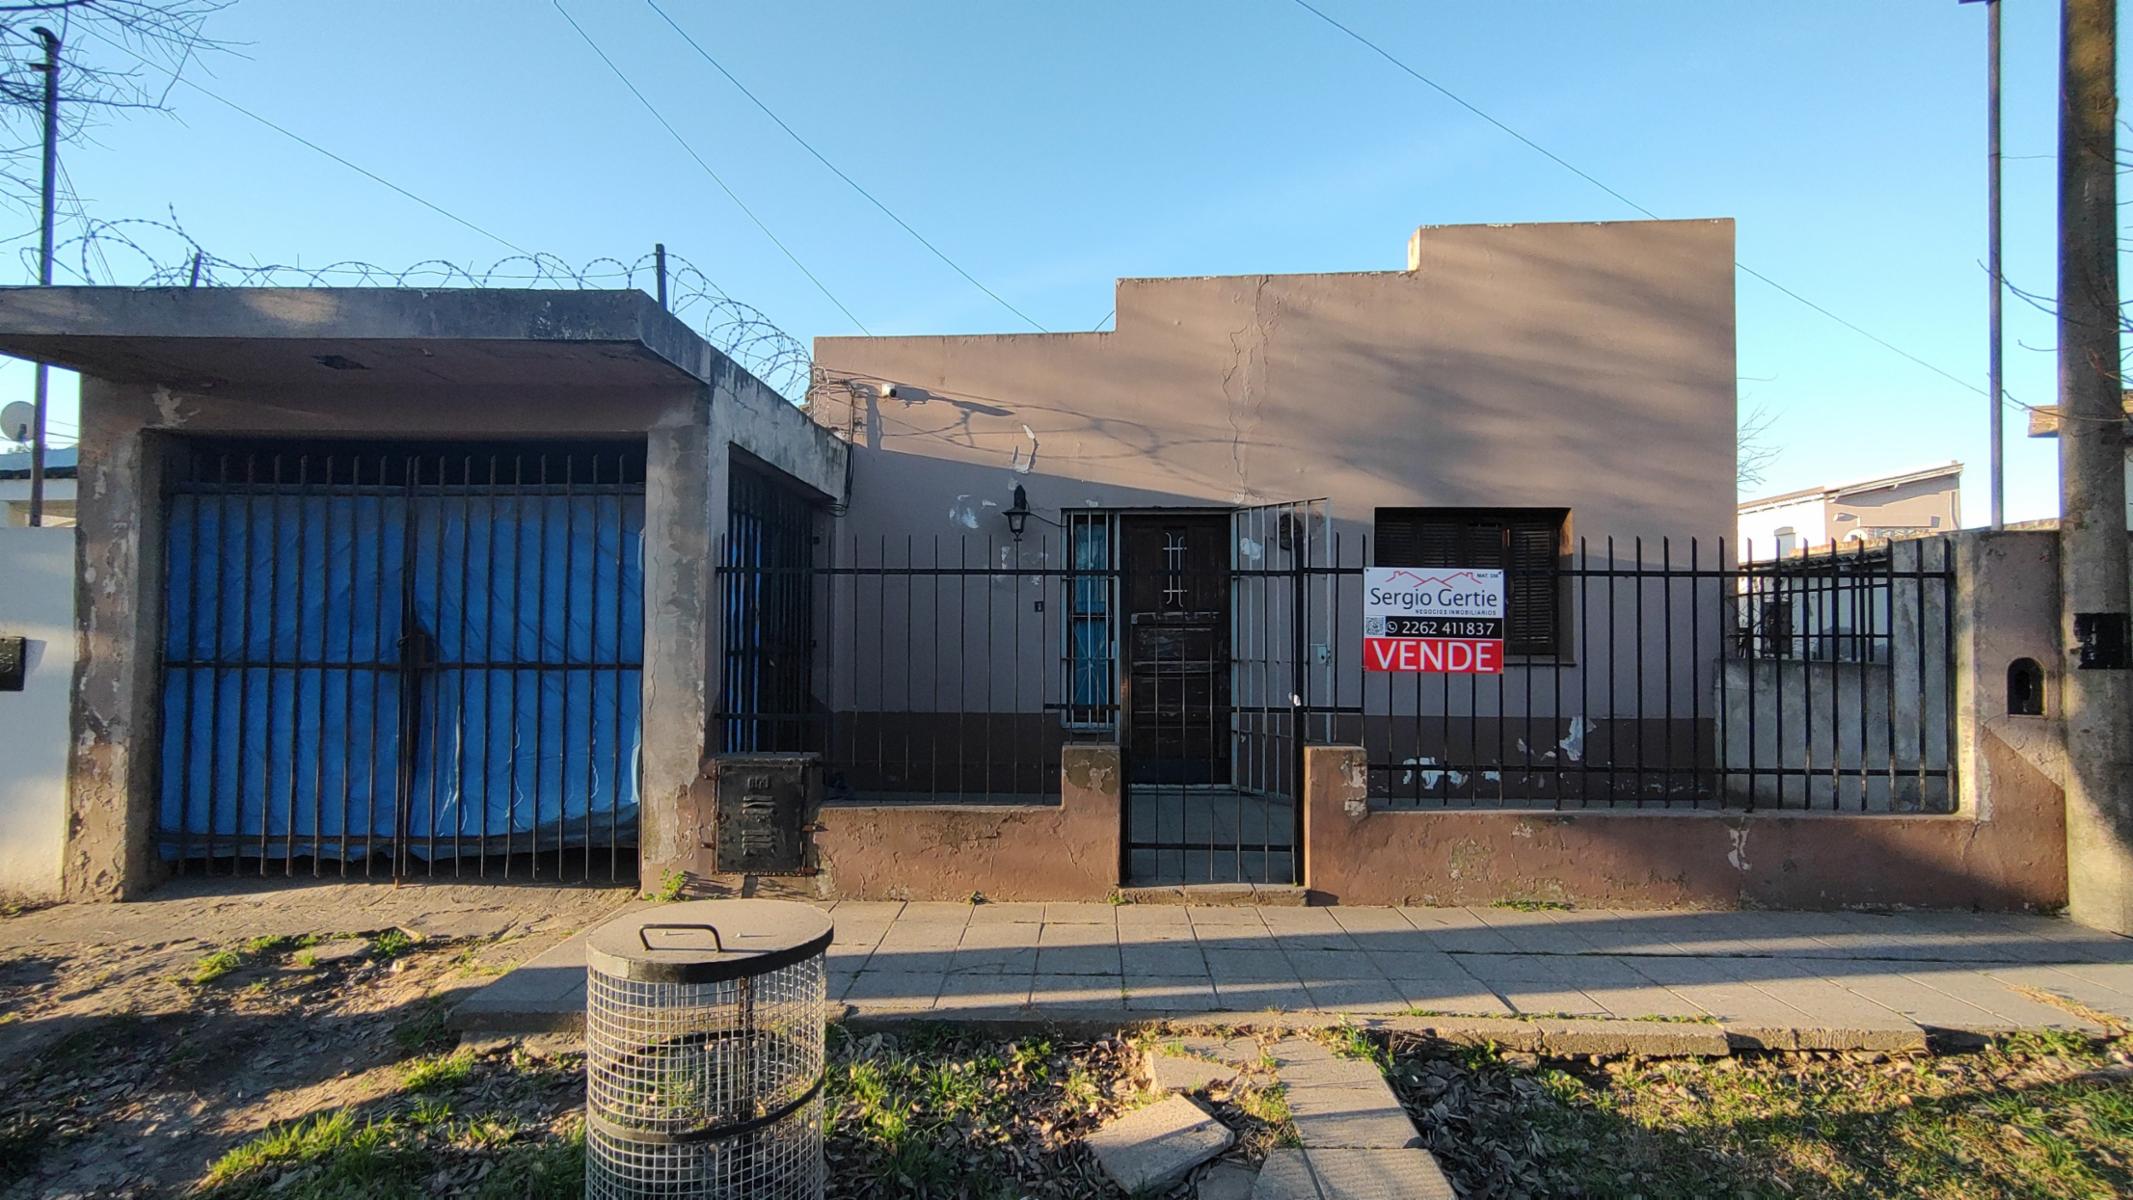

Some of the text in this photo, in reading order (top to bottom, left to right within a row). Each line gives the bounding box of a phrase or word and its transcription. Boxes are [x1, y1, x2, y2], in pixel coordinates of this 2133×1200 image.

[1370, 587, 1497, 610] Sergio Gertie
[1402, 621, 1495, 636] 2262 411837
[1372, 640, 1494, 672] VENDE
